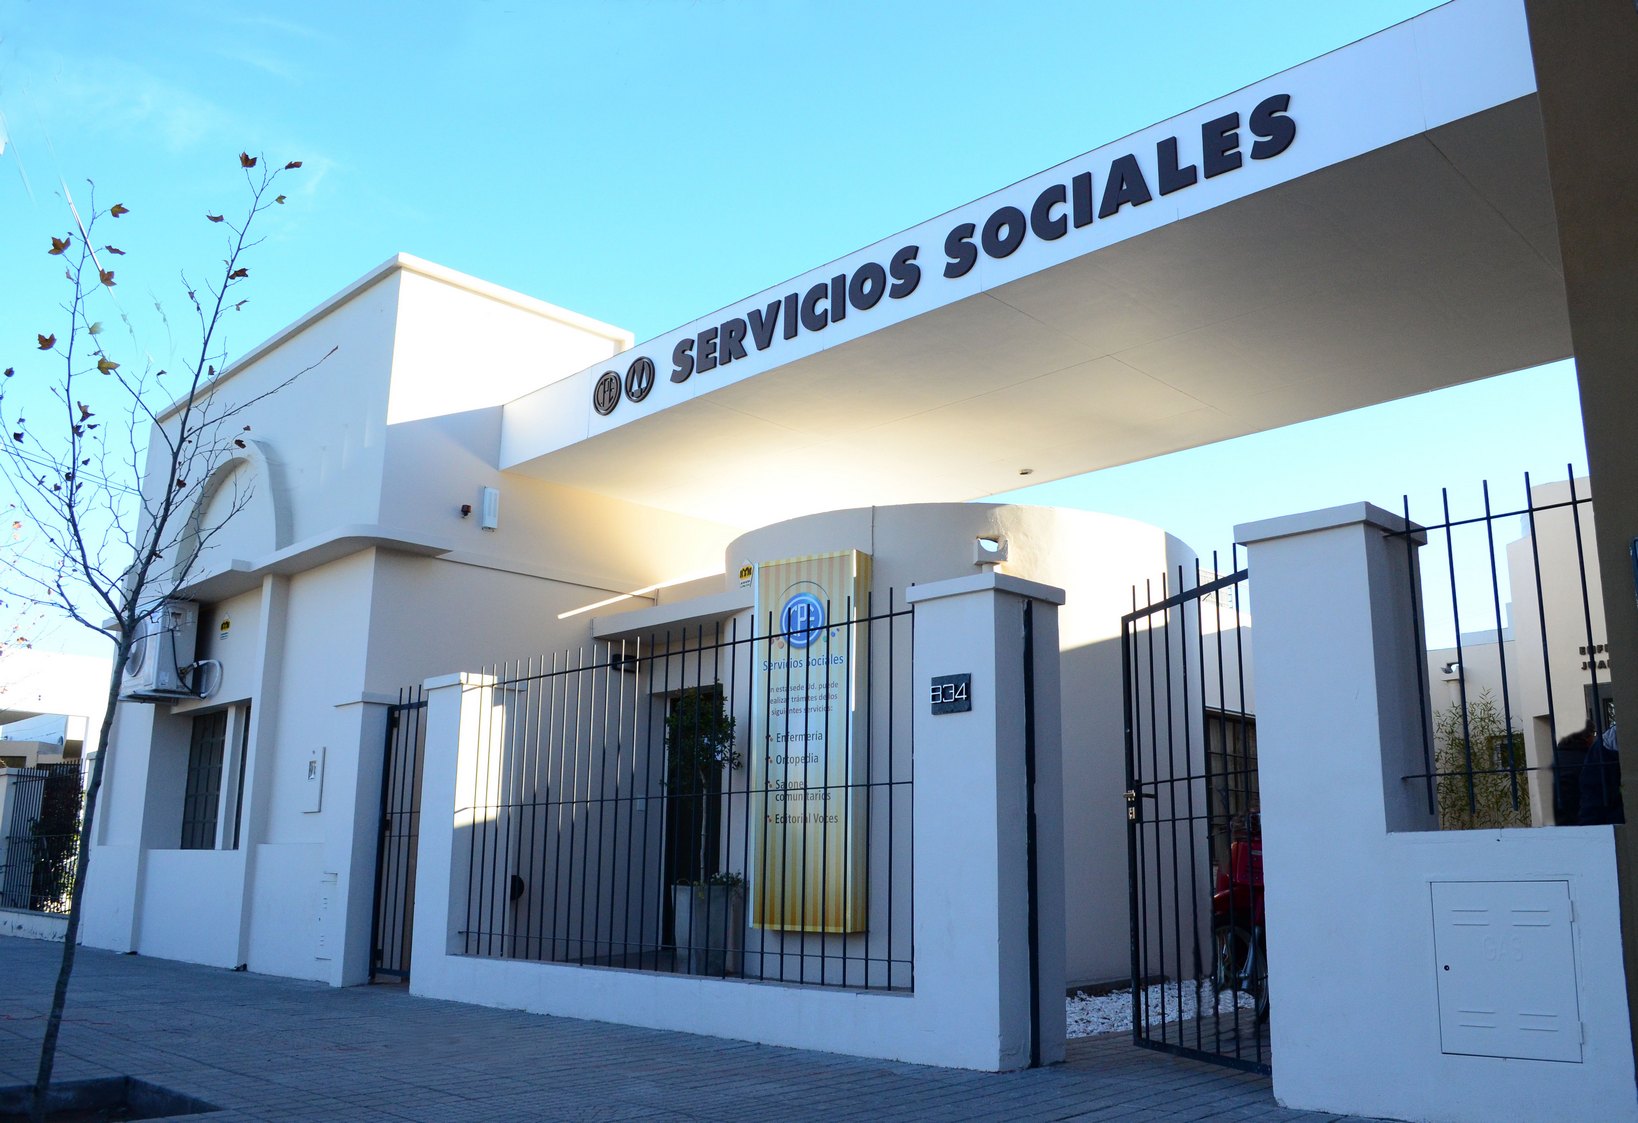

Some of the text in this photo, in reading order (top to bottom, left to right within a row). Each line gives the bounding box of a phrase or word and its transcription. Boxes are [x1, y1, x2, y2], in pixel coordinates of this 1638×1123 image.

[669, 93, 1297, 384] SERVICIOS SOCIALES
[789, 683, 805, 692] sede
[818, 680, 839, 690] pude
[930, 682, 967, 704] 834
[767, 696, 789, 704] ealiza
[791, 695, 817, 703] trámtes
[771, 707, 802, 716] siguintes
[775, 780, 807, 790] Saone
[775, 790, 831, 801] comuntarios
[775, 813, 810, 824] Edtoril
